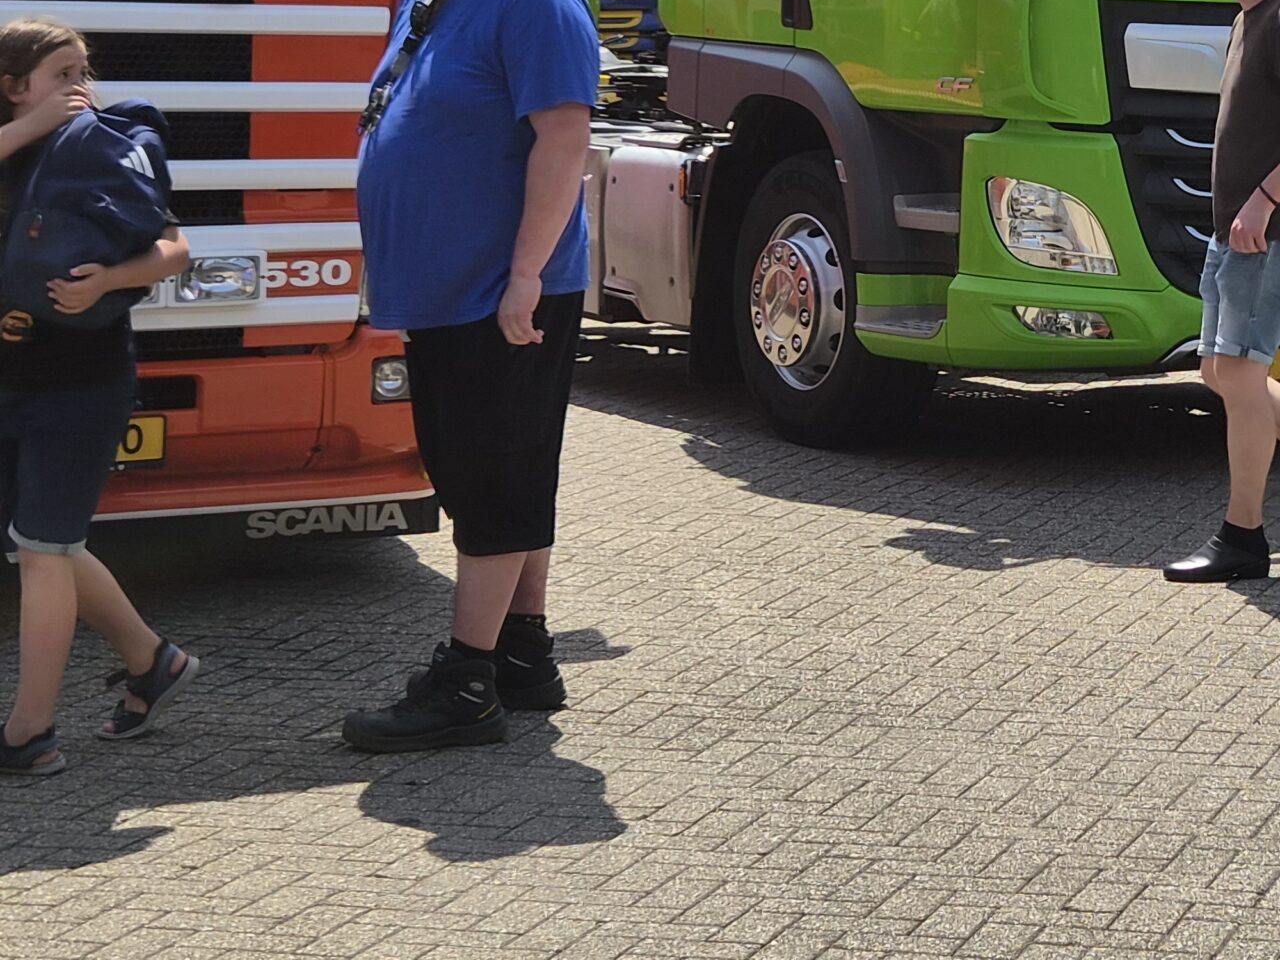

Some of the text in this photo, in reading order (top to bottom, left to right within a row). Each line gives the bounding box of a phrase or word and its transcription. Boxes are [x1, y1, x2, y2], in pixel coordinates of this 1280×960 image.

[936, 75, 977, 94] CF
[263, 258, 352, 289] 530
[245, 502, 409, 539] SCANIA
